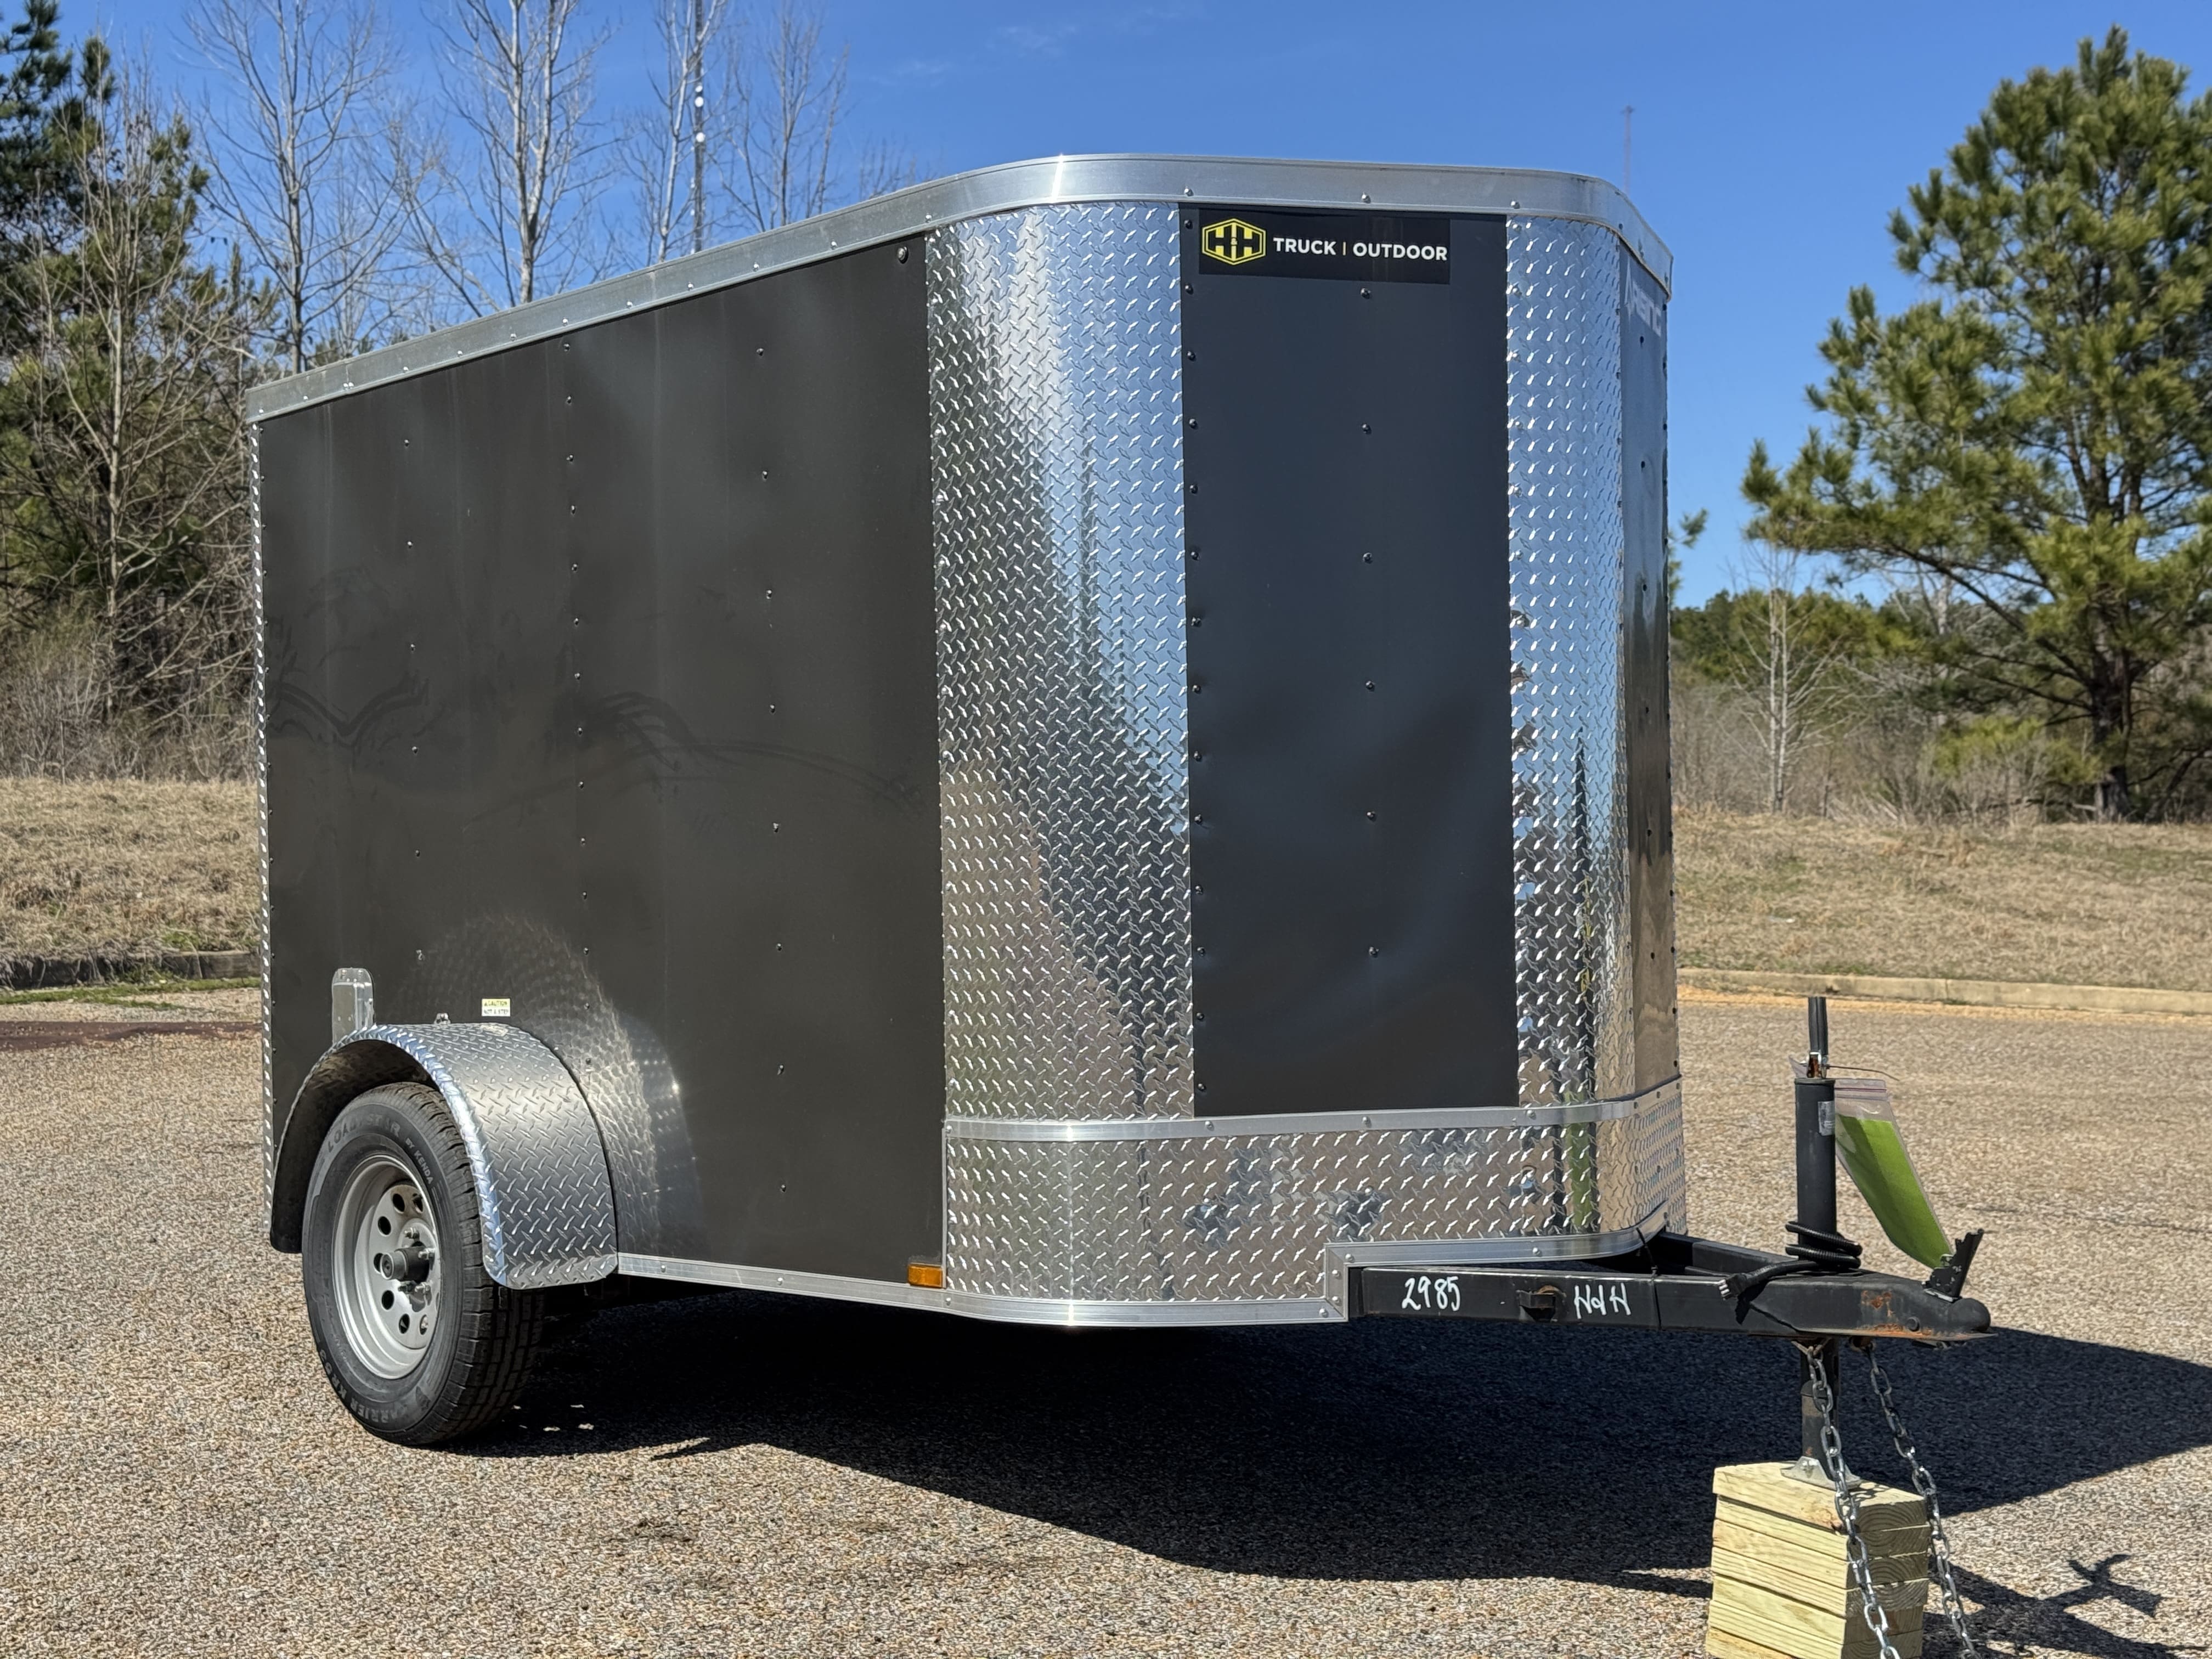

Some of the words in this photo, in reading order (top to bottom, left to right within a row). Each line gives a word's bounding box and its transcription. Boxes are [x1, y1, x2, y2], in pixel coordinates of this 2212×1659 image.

[1273, 237, 1336, 255] TRUCK
[1353, 242, 1448, 261] OUTDOOR
[405, 1138, 415, 1149] BY
[414, 1150, 434, 1184] KENDA
[1402, 1276, 1461, 1312] 2985
